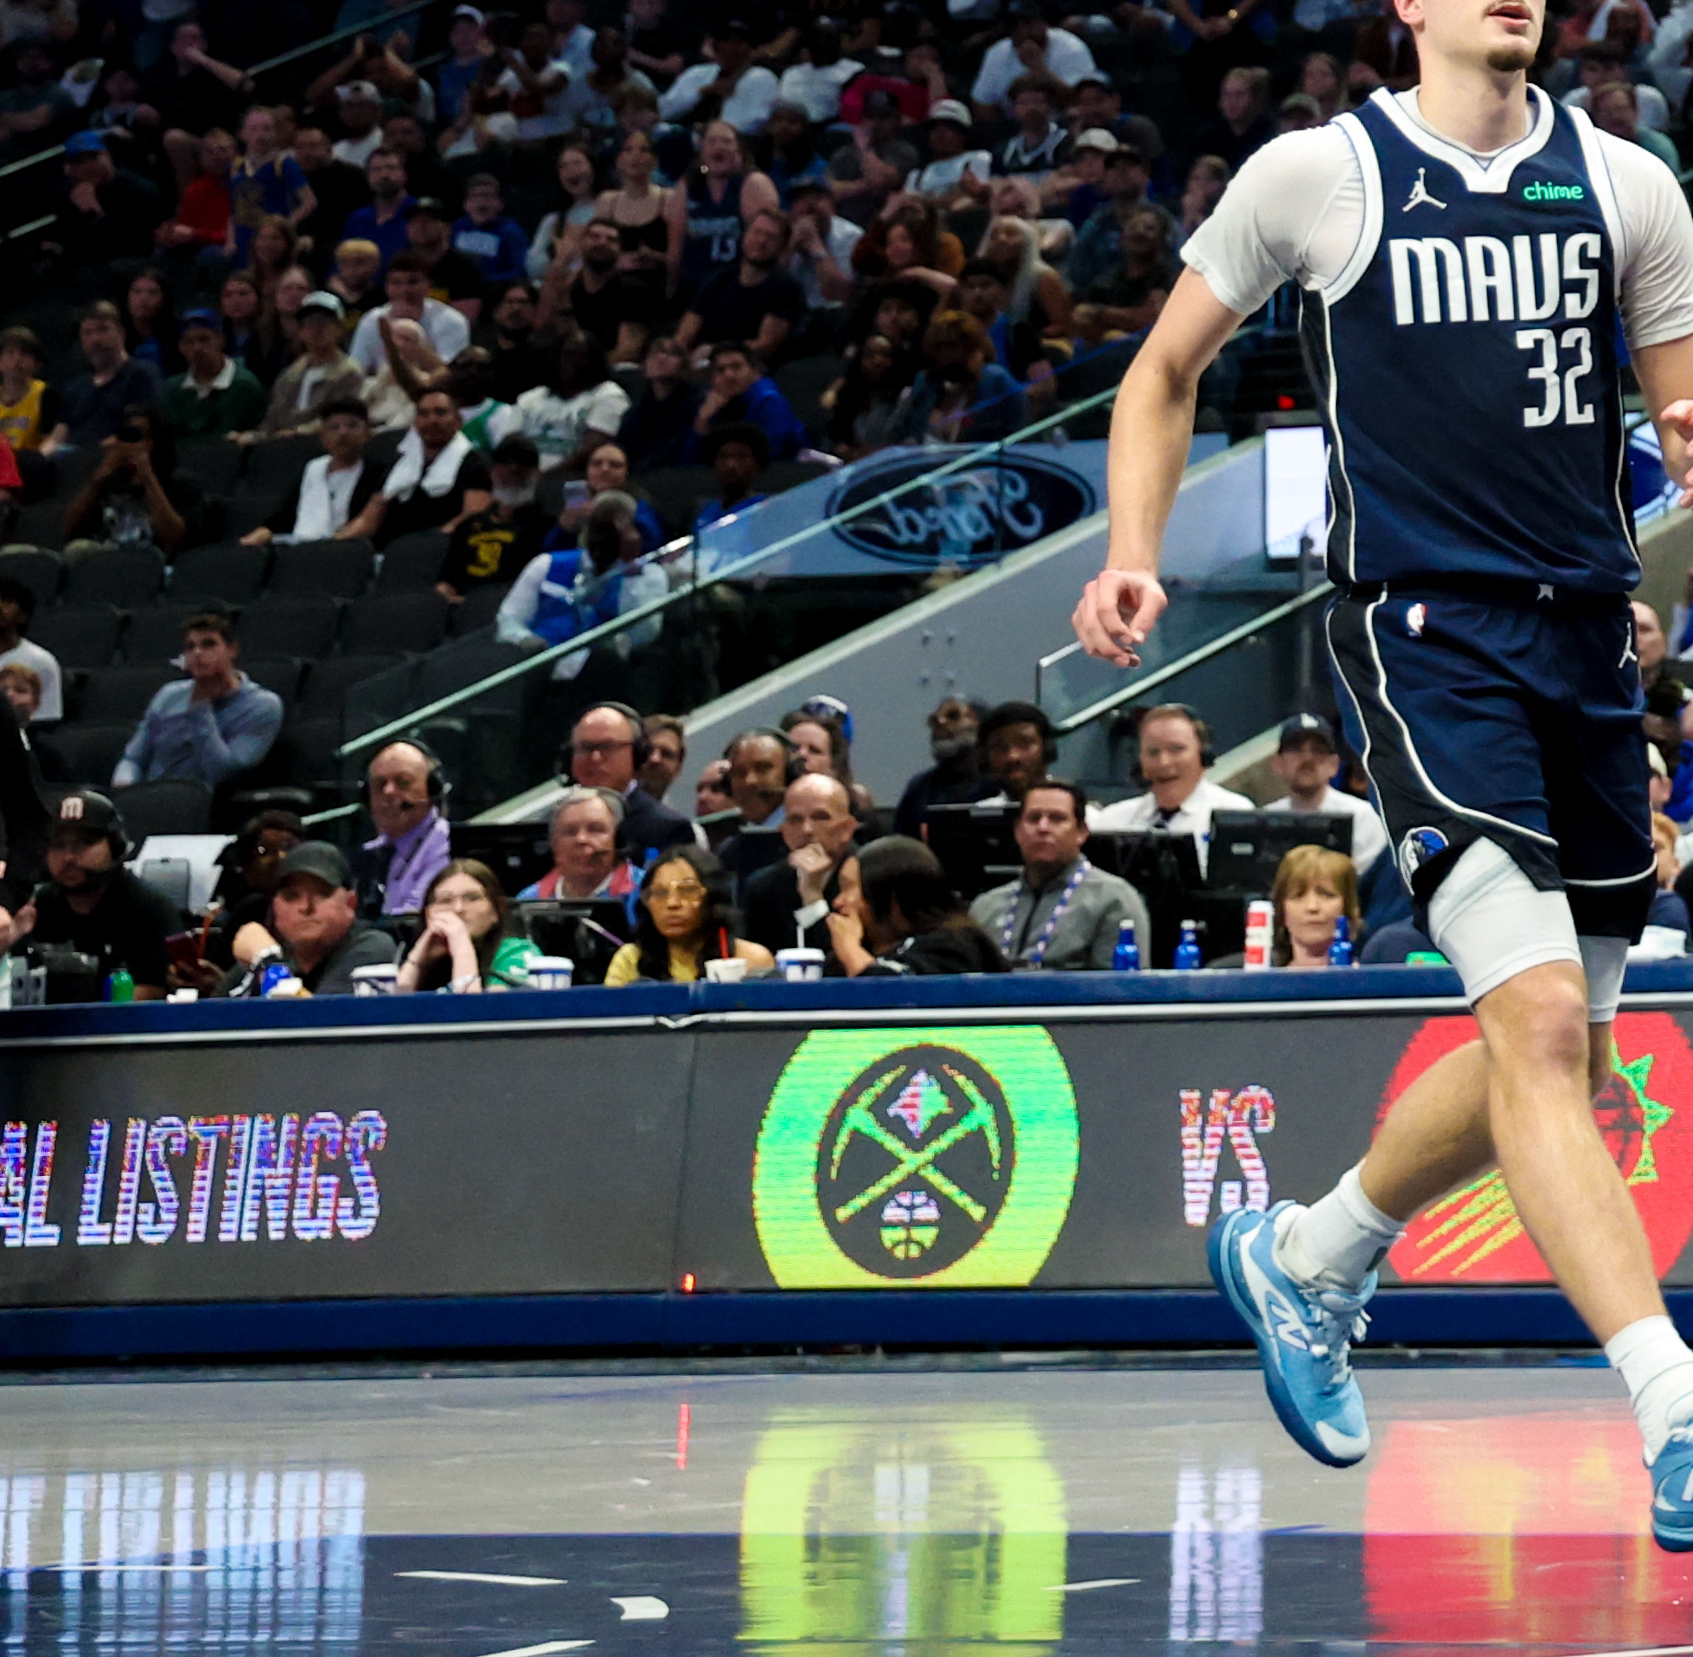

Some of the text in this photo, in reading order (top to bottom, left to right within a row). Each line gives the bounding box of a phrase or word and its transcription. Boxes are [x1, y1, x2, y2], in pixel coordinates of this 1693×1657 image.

[1523, 180, 1584, 202] chime
[1518, 329, 1596, 428] 32
[76, 1109, 388, 1246] LISTINGS
[1180, 1084, 1276, 1227] VS
